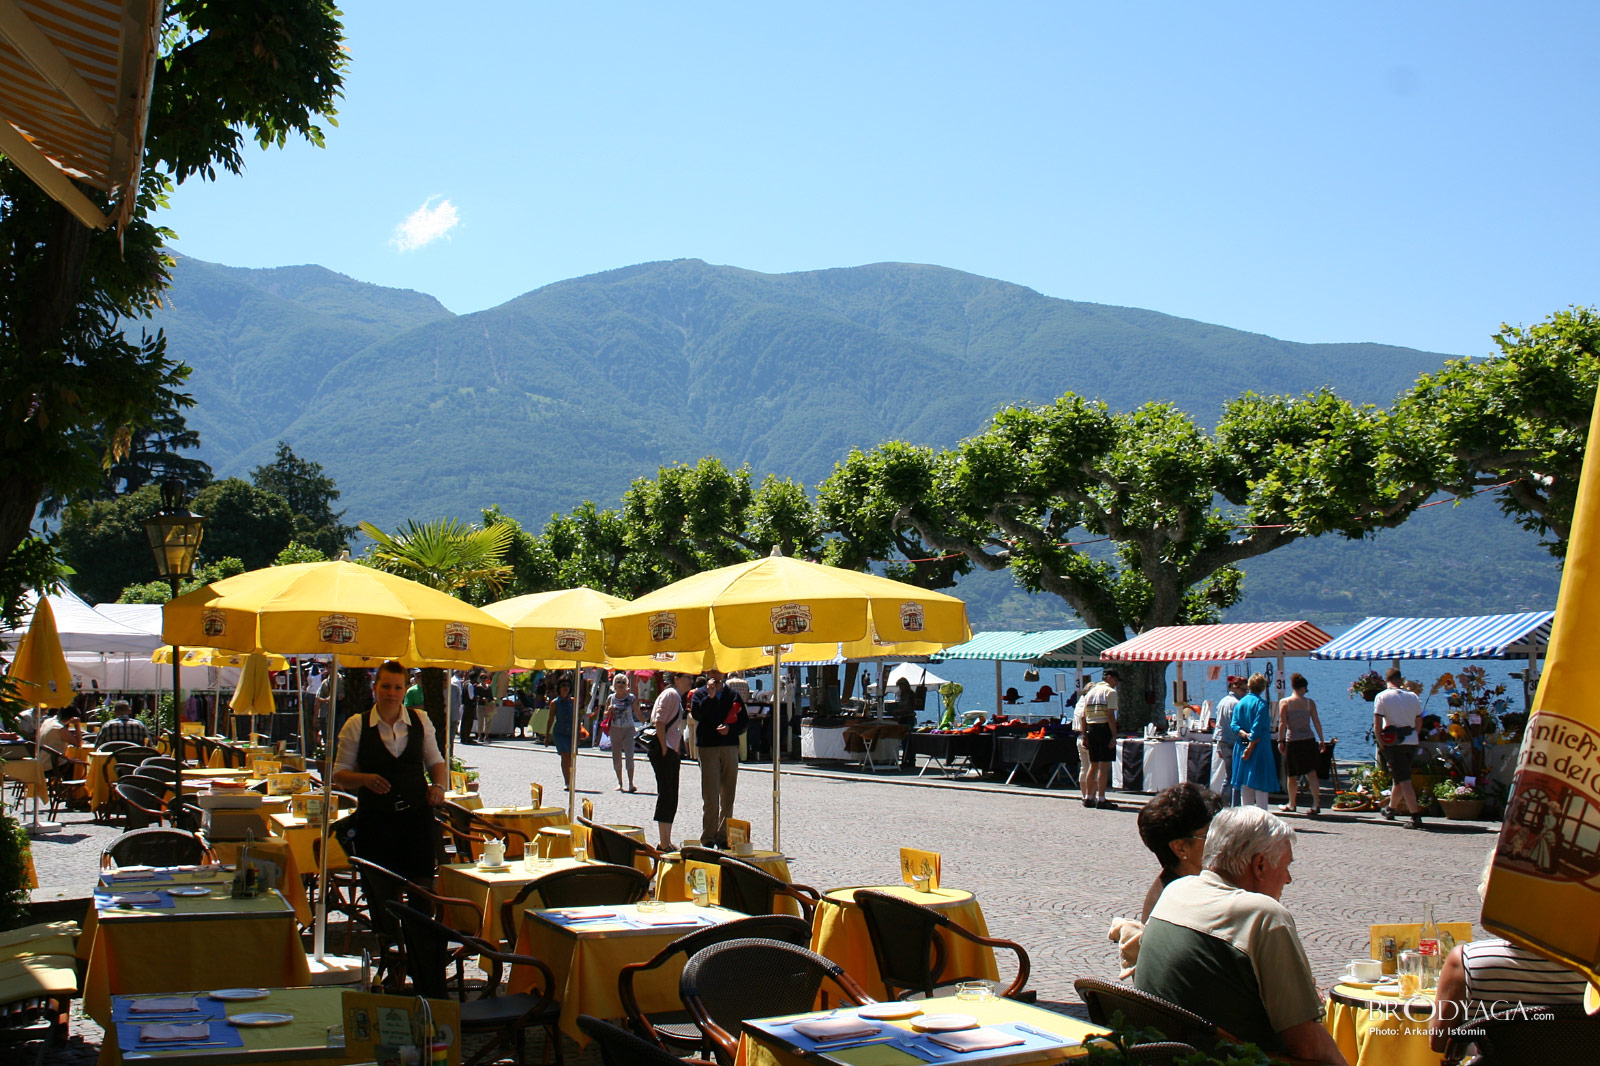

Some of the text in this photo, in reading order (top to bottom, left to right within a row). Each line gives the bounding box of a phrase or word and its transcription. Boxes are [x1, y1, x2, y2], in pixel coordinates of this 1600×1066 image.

[1276, 679, 1286, 690] 31
[1518, 745, 1548, 768] ria
[1553, 755, 1592, 785] del
